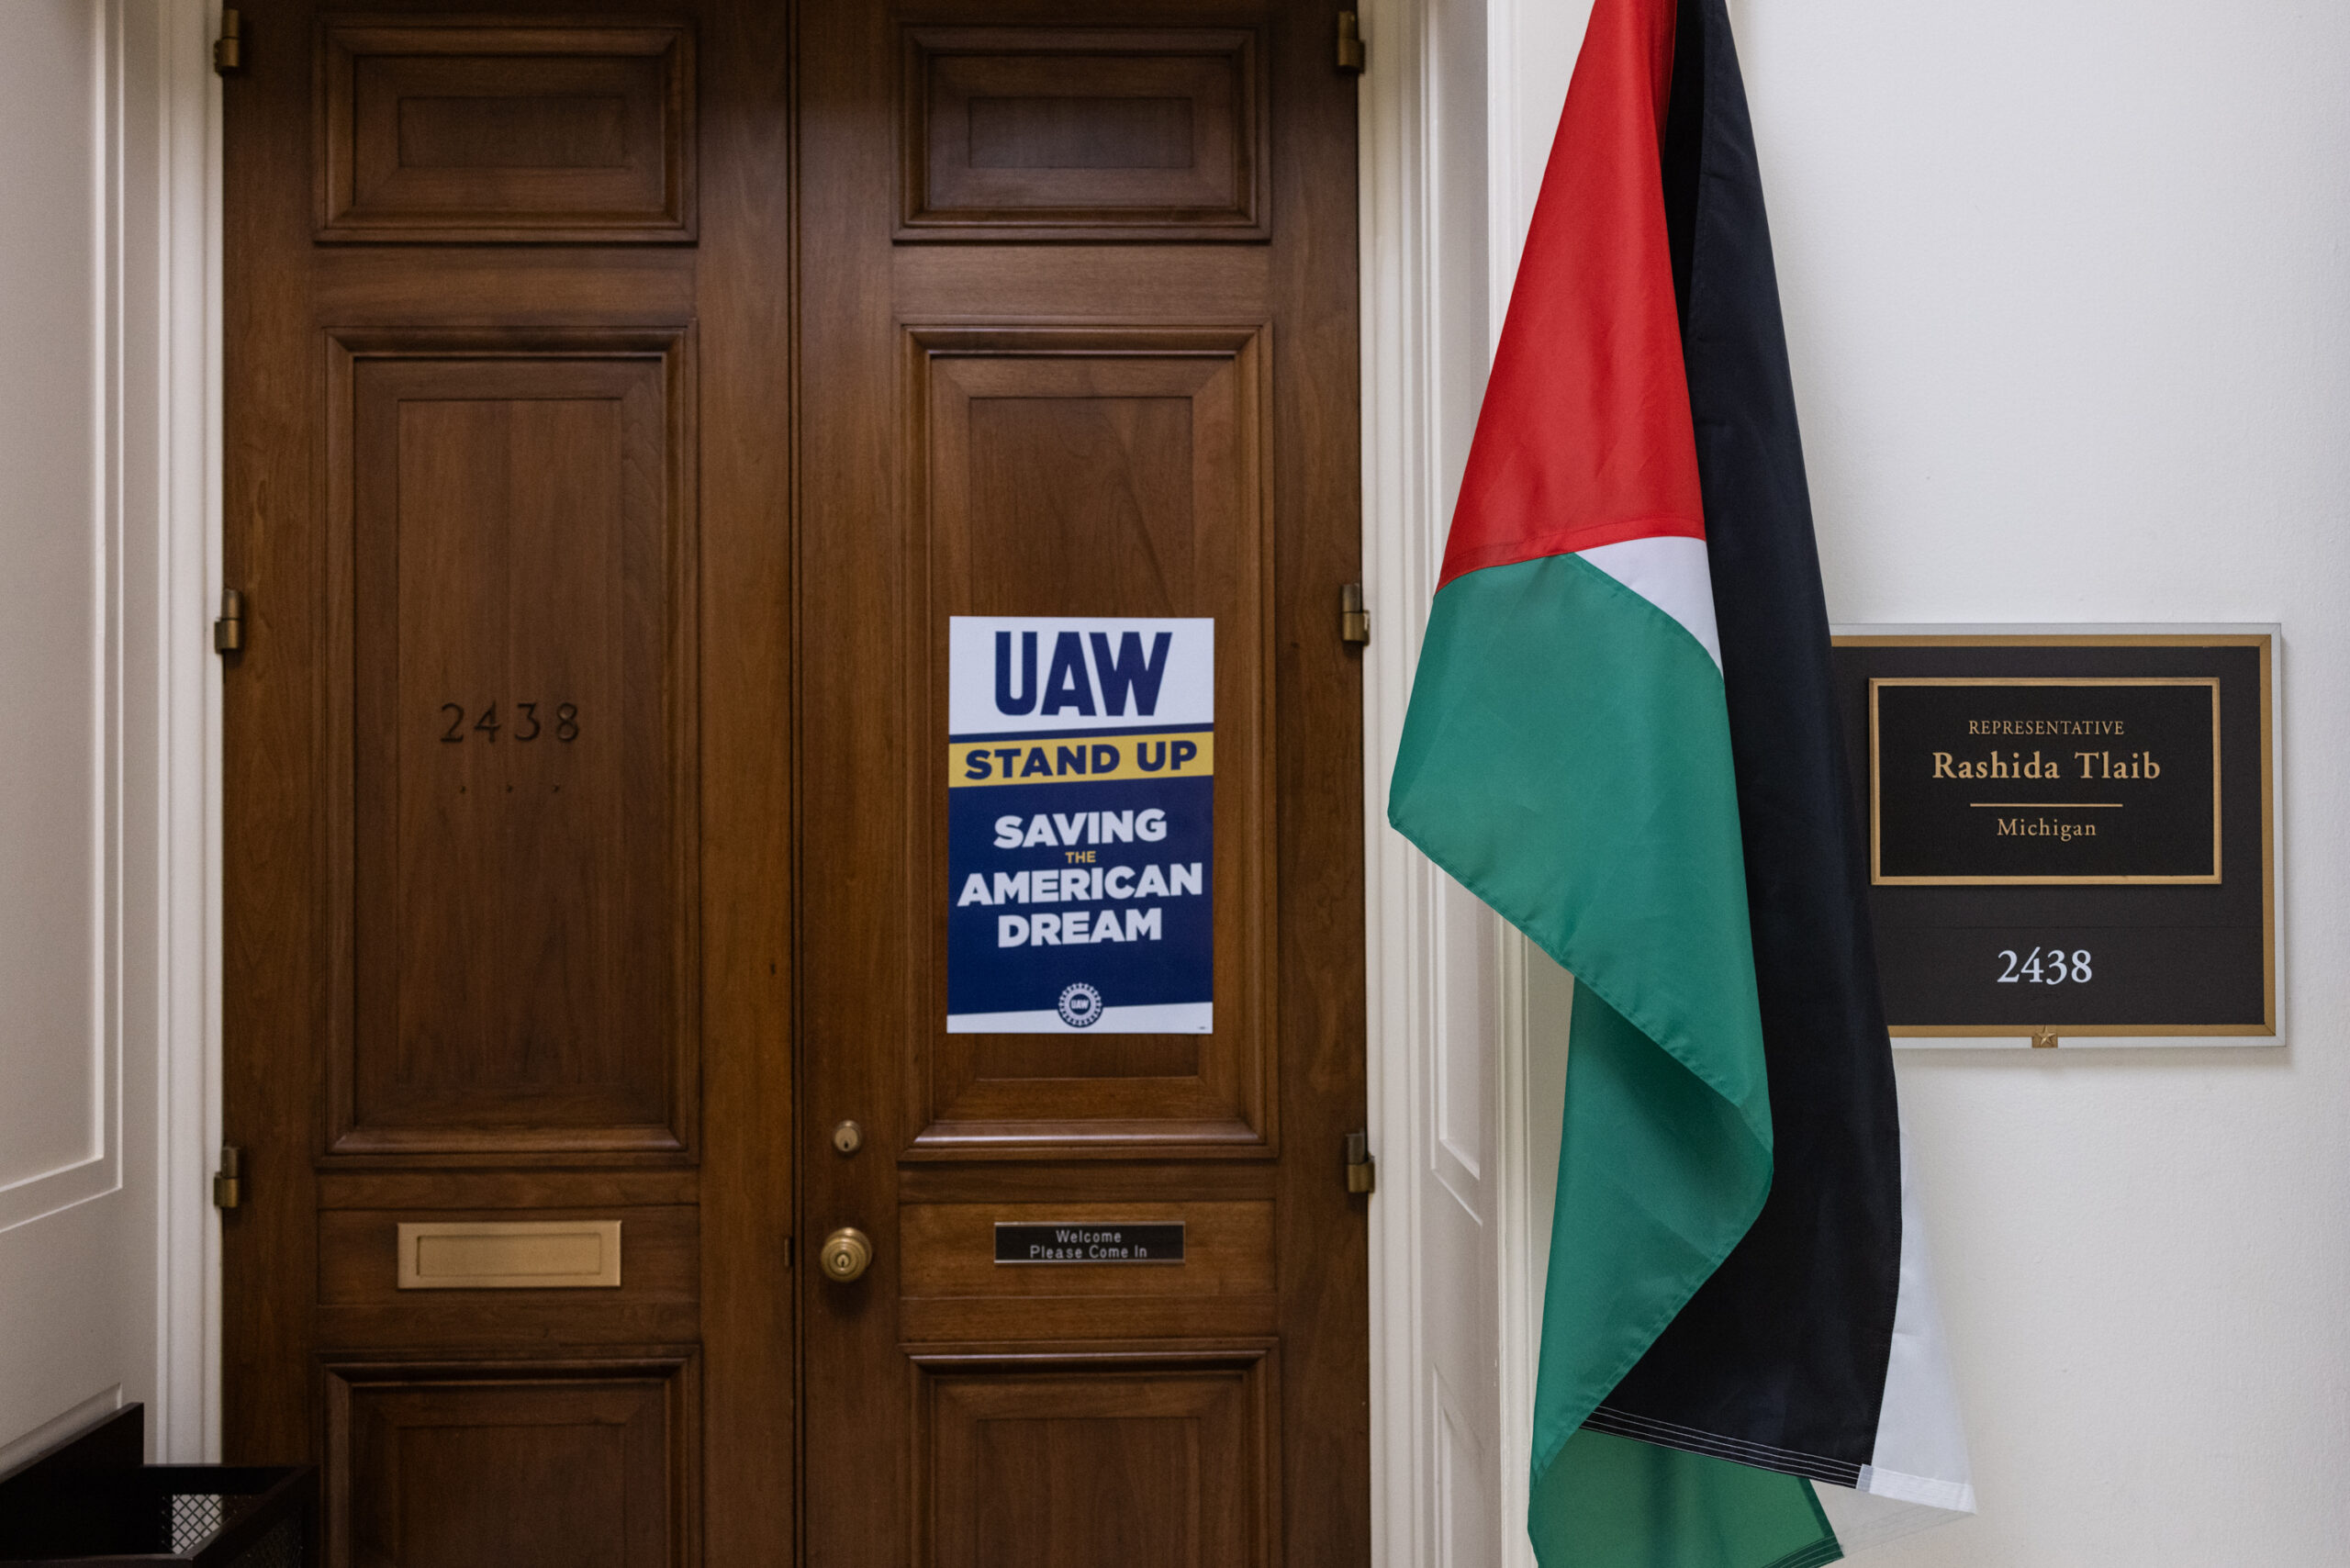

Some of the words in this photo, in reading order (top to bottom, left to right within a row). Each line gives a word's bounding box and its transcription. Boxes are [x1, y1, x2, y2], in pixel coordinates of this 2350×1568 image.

[995, 631, 1172, 717] UAW
[440, 700, 579, 744] 2438
[1968, 720, 2125, 736] REPRESENTATIVE
[965, 745, 1121, 780] STAND
[1136, 740, 1198, 772] UP
[1931, 751, 2061, 780] Rashida
[2075, 751, 2161, 780] Tlaib
[993, 808, 1168, 849] SAVING
[1997, 818, 2098, 842] Michigan
[1065, 850, 1097, 864] THE
[957, 862, 1203, 907] AMERICAN
[998, 907, 1162, 948] DREAM
[1997, 946, 2093, 985] 2438
[1070, 999, 1089, 1010] UAW
[1029, 1245, 1083, 1259] Please
[1089, 1245, 1129, 1259] Come
[1135, 1245, 1147, 1259] In
[1056, 1229, 1122, 1243] Welcome
